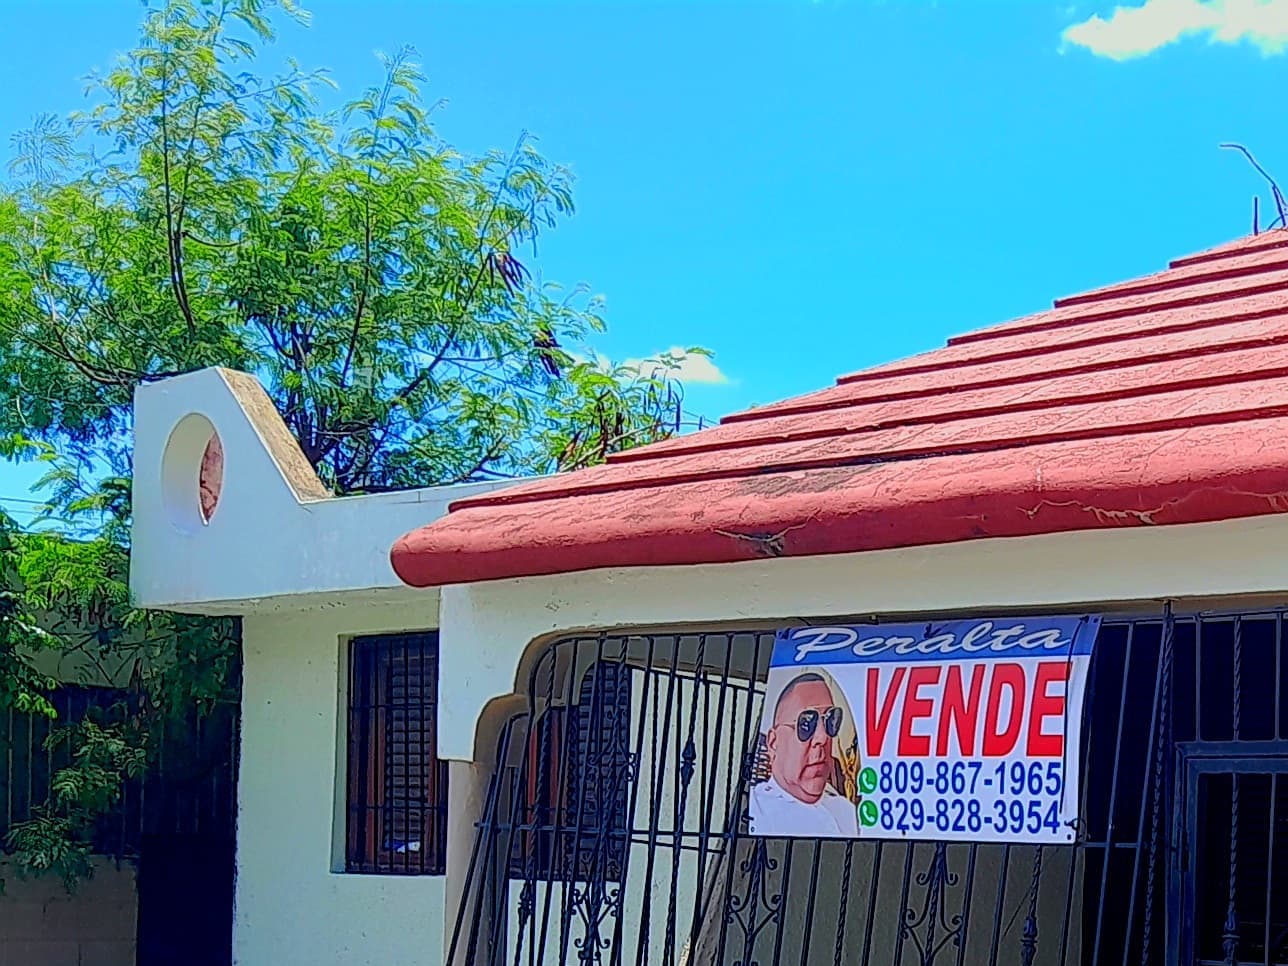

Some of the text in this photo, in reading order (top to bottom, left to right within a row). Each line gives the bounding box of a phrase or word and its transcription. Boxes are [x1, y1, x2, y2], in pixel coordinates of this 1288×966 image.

[791, 621, 1071, 662] Peralta
[866, 661, 1073, 757] VENDE
[879, 761, 1061, 796] 809-867-1965
[880, 799, 1061, 834] 829-828-3954
